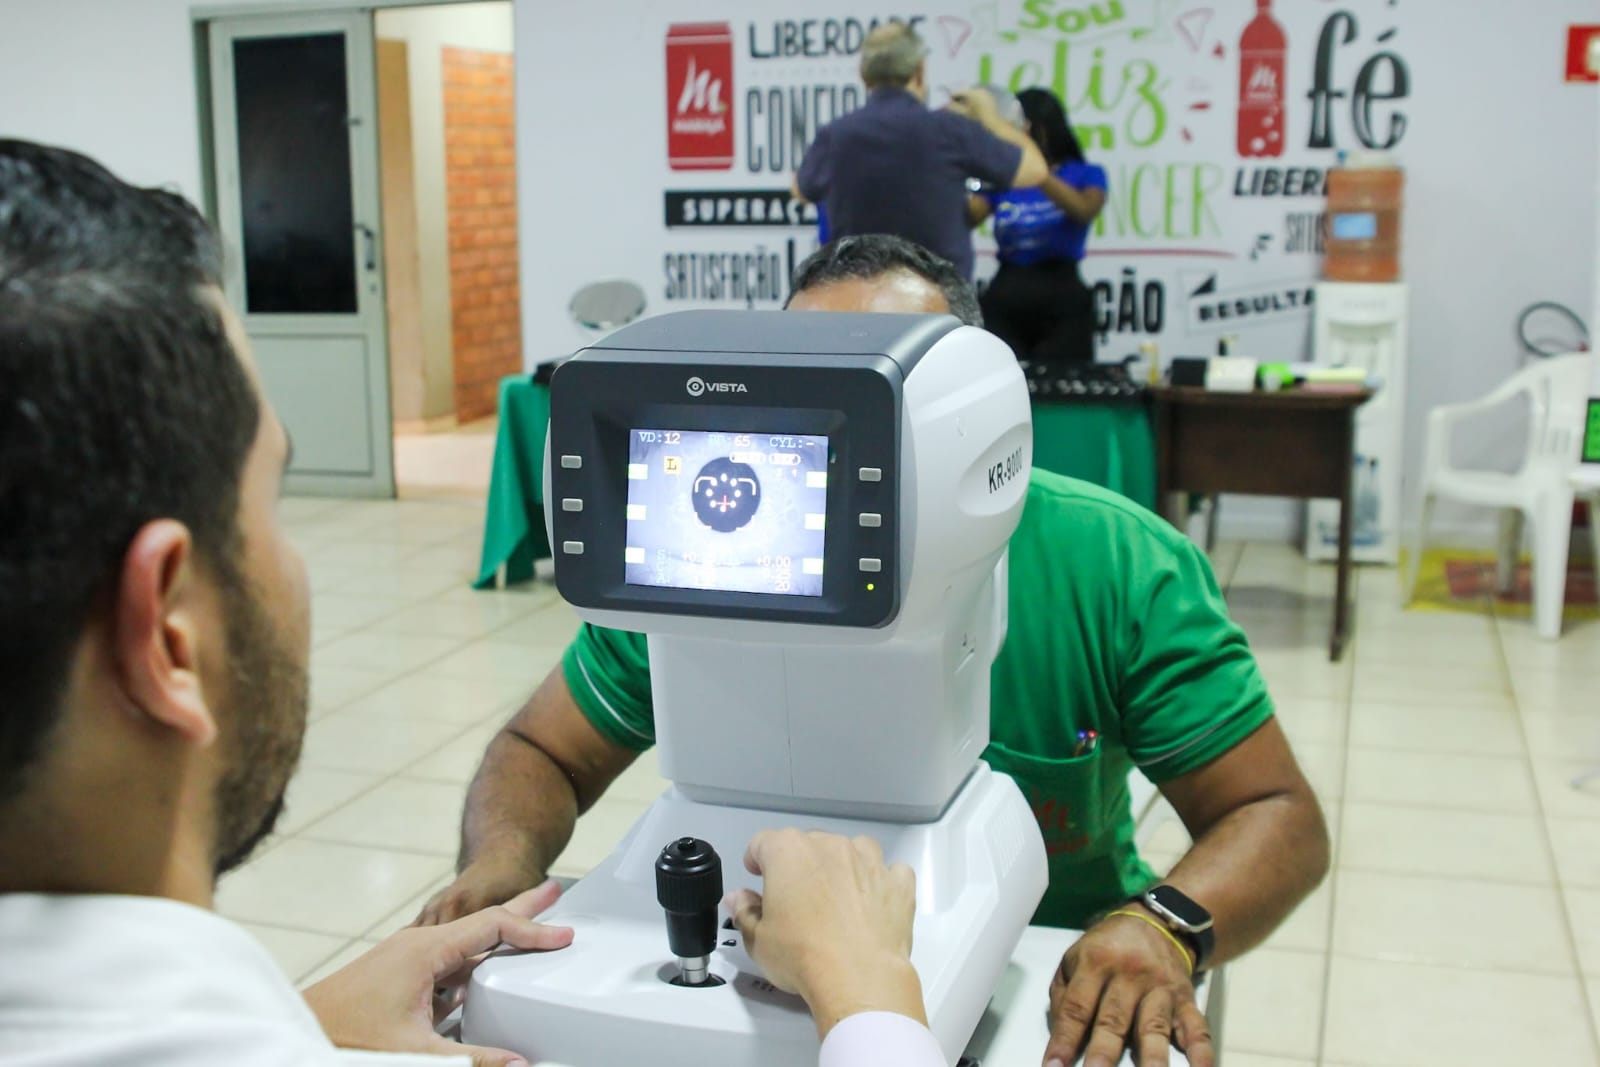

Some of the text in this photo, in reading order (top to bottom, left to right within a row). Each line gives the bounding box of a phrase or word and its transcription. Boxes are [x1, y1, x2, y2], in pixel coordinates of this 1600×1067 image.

[748, 15, 926, 58] LIBERD
[1307, 9, 1409, 149] fé
[705, 382, 748, 393] VISTA
